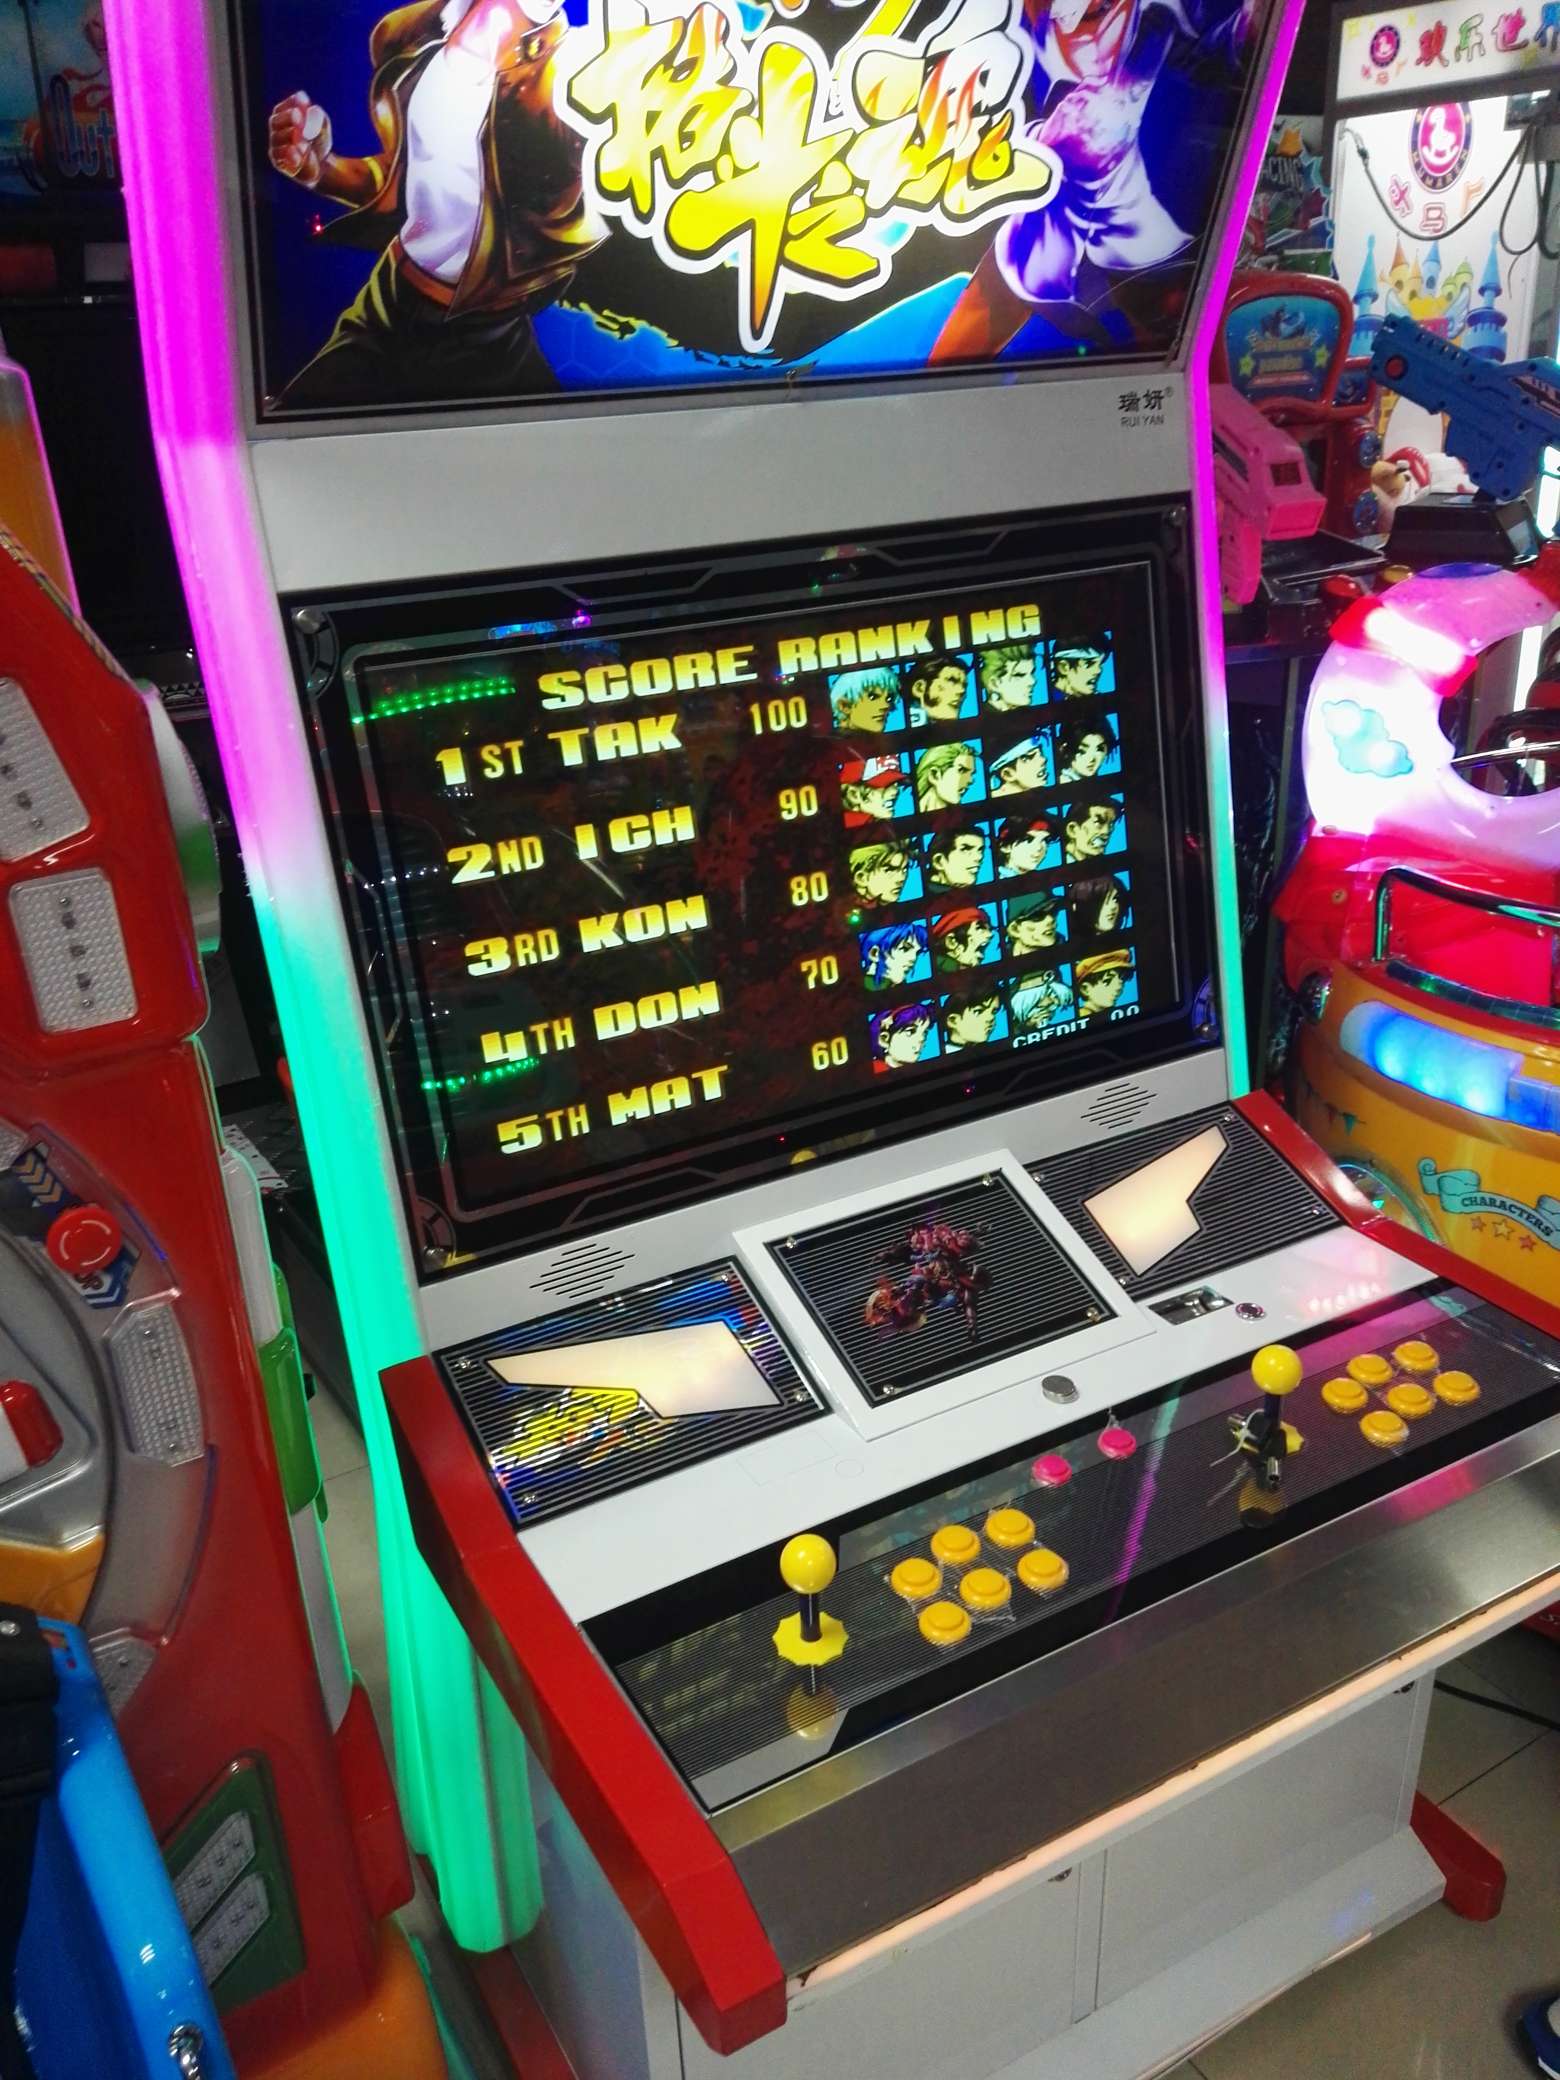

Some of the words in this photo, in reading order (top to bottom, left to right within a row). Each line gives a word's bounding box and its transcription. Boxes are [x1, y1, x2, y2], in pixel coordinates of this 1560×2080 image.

[1120, 415, 1140, 428] RUI
[1142, 414, 1165, 426] YAN
[537, 644, 758, 711] SCORE
[777, 604, 1042, 676] RANKING
[547, 713, 682, 767] TAK
[750, 696, 808, 735] 100
[447, 836, 544, 884] 2ND
[574, 805, 695, 860] ICH
[779, 784, 819, 821] 90
[464, 928, 560, 977] 3RD
[578, 894, 708, 953] KON
[789, 871, 829, 907] 80
[481, 1016, 576, 1064] 4TH
[593, 980, 721, 1041] DON
[800, 955, 839, 990] 70
[496, 1103, 590, 1155] 5TH
[607, 1064, 729, 1126] MAT
[811, 1036, 849, 1071] 60
[1461, 1196, 1554, 1237] CHARACTERS
